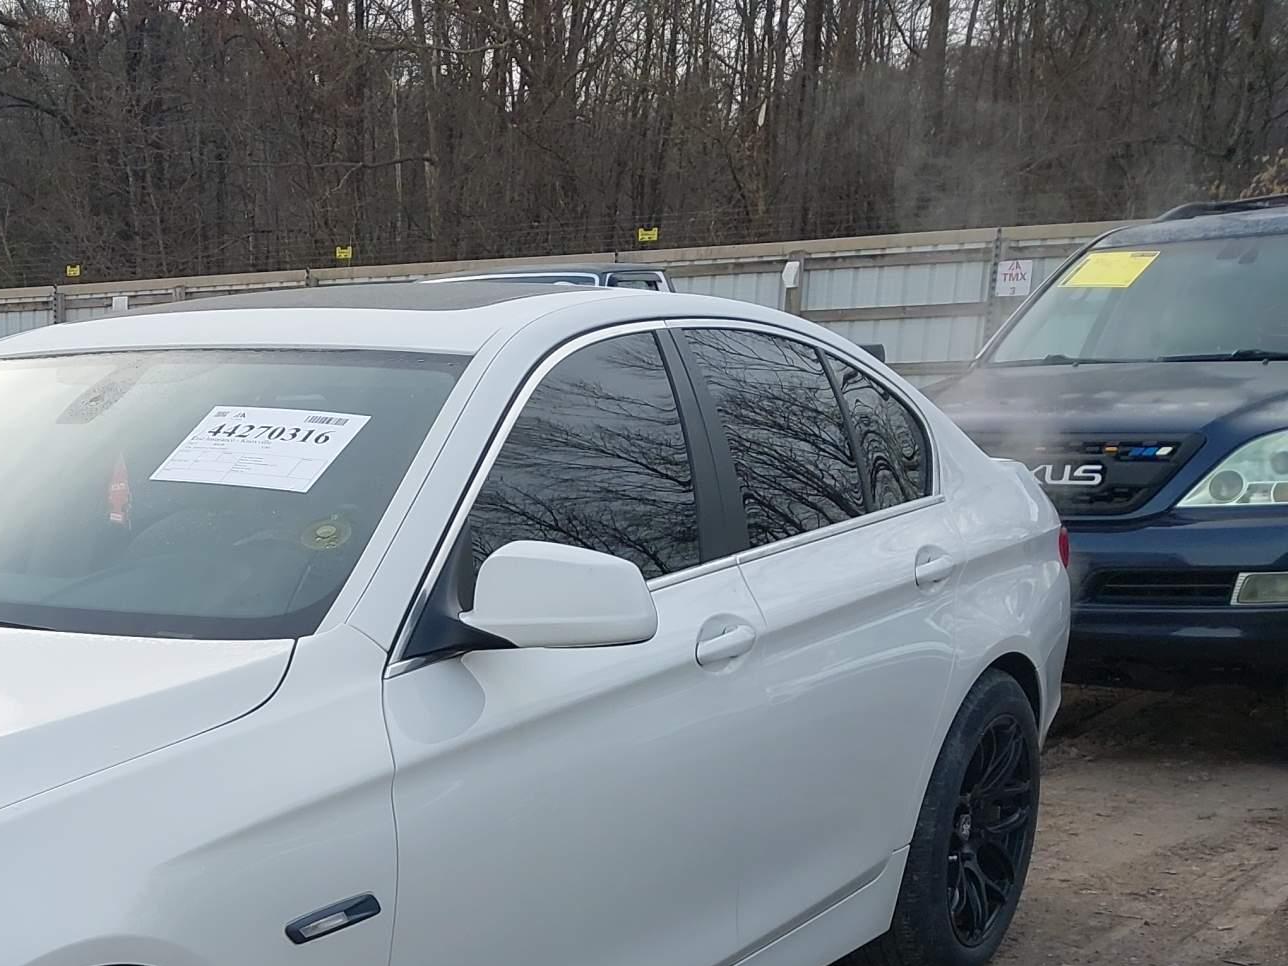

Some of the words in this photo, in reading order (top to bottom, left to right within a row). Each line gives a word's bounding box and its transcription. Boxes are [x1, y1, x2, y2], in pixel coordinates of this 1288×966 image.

[1001, 271, 1027, 282] TMX
[207, 423, 336, 445] 44270316
[1032, 464, 1103, 485] XUS
